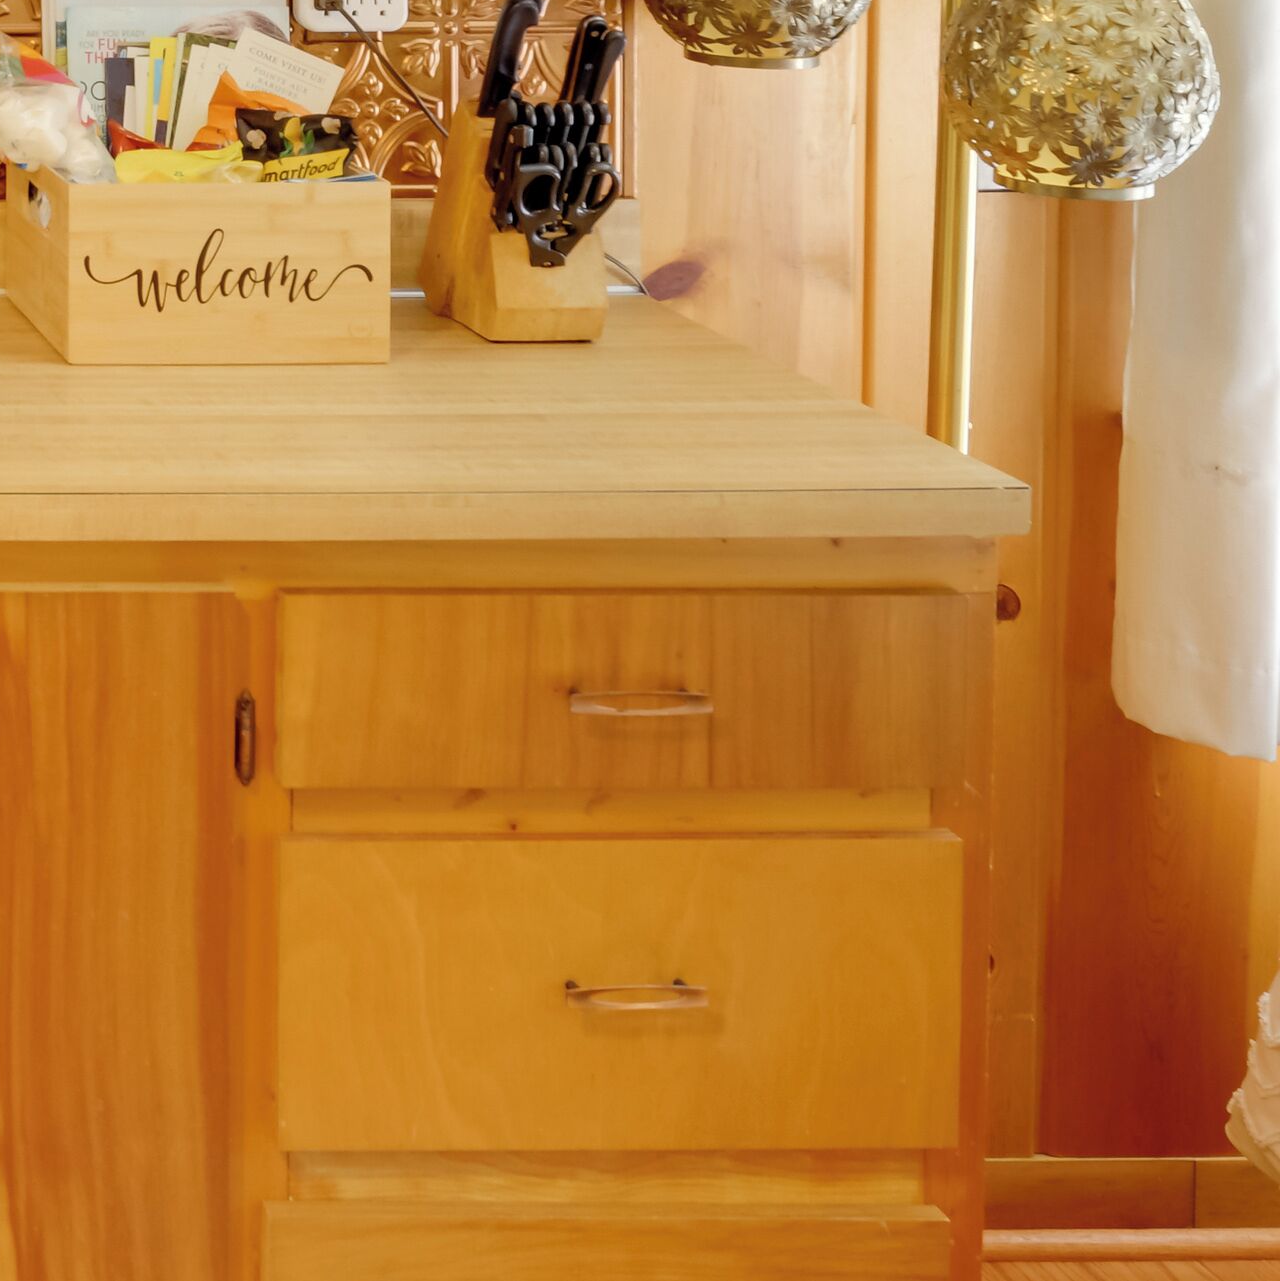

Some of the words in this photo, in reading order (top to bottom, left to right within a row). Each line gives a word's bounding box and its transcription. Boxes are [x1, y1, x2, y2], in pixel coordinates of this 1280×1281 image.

[249, 46, 278, 65] COME
[281, 59, 308, 77] VISIT
[264, 157, 340, 182] martfood
[84, 228, 373, 312] welcome
